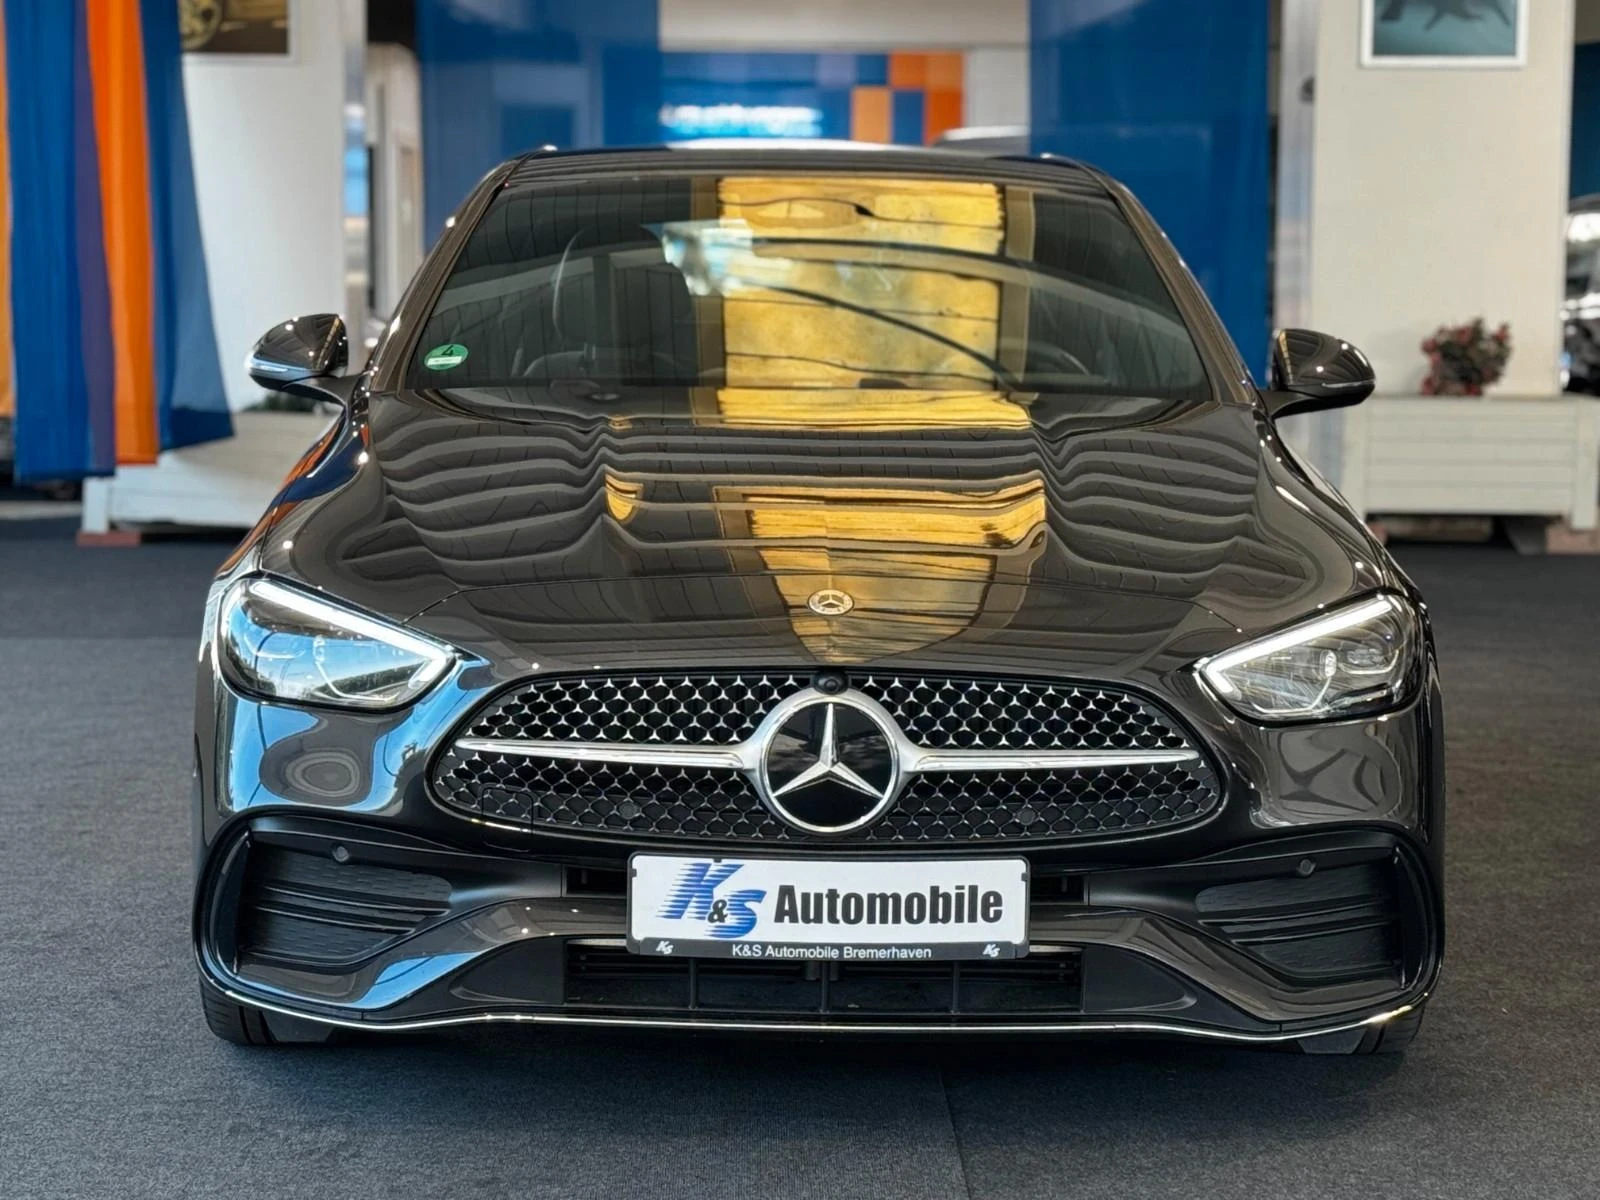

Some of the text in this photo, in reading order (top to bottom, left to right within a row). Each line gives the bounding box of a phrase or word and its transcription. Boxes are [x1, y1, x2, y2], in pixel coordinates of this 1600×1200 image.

[441, 344, 454, 356] 4
[656, 863, 1003, 939] K&S Automobile
[732, 944, 932, 960] K&S Automobile Bremerhaven
